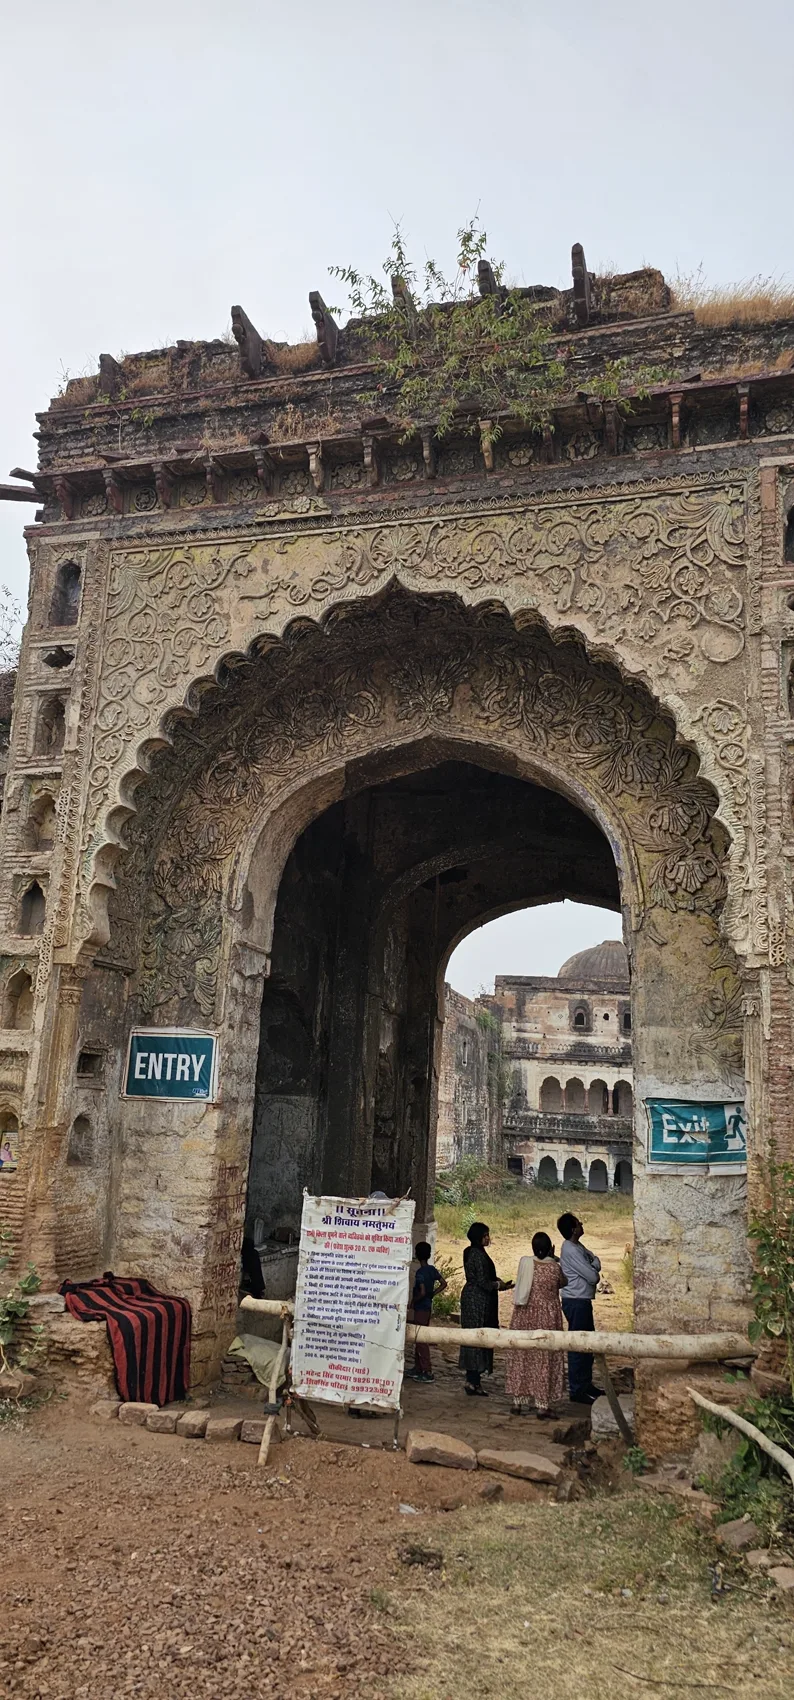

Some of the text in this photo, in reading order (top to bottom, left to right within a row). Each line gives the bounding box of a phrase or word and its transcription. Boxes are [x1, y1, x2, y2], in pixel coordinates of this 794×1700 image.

[135, 1053, 206, 1081] ENTRY
[662, 1113, 711, 1143] Exit
[322, 1215, 332, 1225] श्री
[334, 1216, 360, 1226] शिवाय
[383, 1234, 393, 1242] किया
